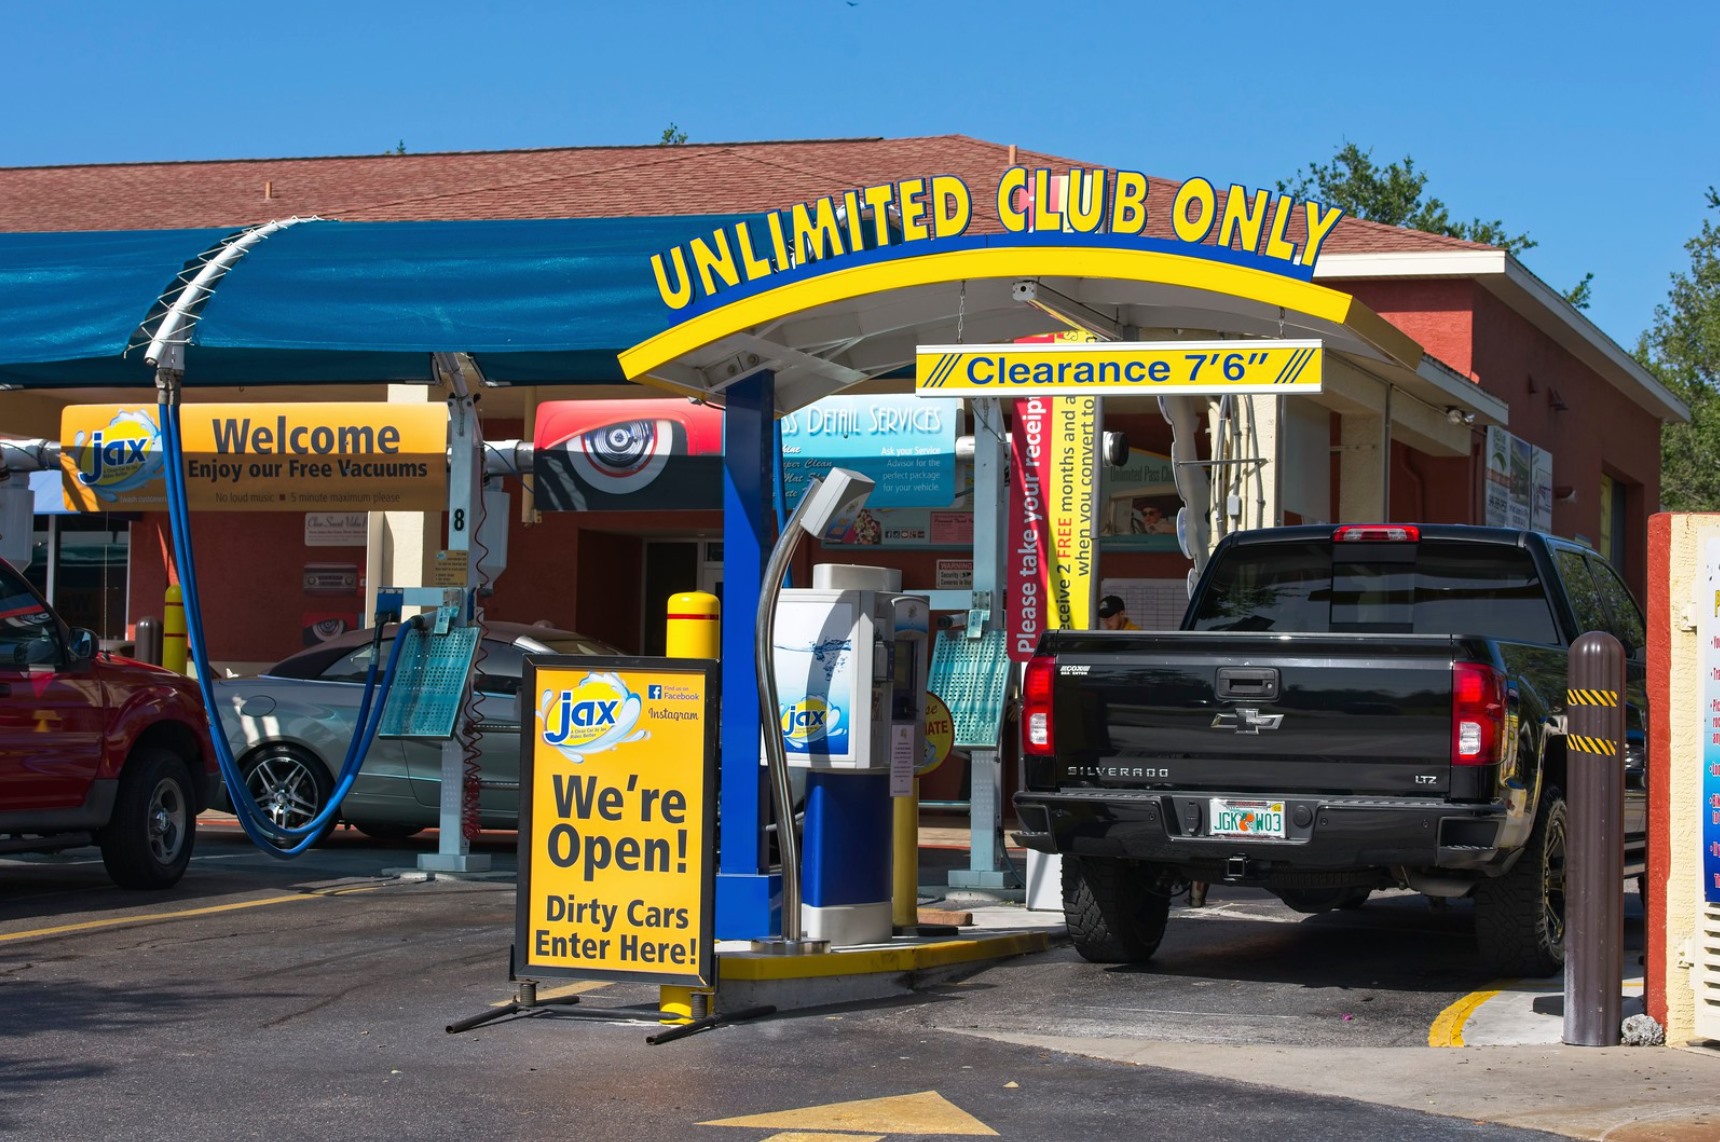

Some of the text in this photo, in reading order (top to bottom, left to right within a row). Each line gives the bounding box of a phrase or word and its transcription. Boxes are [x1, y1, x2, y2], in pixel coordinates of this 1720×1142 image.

[650, 165, 1346, 310] UNLIMITED CLUB ONLY
[967, 353, 1170, 386] Clearance
[212, 415, 401, 455] Welcome
[1061, 410, 1076, 442] and
[804, 458, 833, 468] Clean
[881, 446, 941, 457] Ask your Service
[887, 458, 941, 468] Advisor for the
[188, 459, 428, 482] Enjoy our Free Vacuums
[883, 471, 941, 482] perfect package
[1058, 447, 1075, 512] months
[1144, 465, 1161, 482] Pass
[215, 491, 401, 504] No loud music 5 minute maximum please
[883, 482, 893, 491] for
[893, 485, 911, 494] your
[1024, 473, 1043, 523] your
[1074, 398, 1095, 577] when you convert to
[453, 508, 465, 531] 8
[1056, 517, 1072, 558] FREE
[940, 562, 972, 570] WARNING
[1017, 529, 1038, 577] take
[1056, 563, 1071, 574] 2
[1016, 582, 1037, 653] Please
[1055, 579, 1071, 630] eceive
[664, 692, 700, 701] Facebook
[544, 690, 619, 744] jax
[648, 707, 699, 722] Instagram
[1067, 766, 1169, 778] SILVERADO
[1415, 775, 1437, 784] LTZ
[552, 774, 687, 824] We're
[1214, 811, 1282, 832] JGK W03
[547, 823, 688, 882] Open!
[546, 894, 689, 932] Dirty Cars
[535, 929, 697, 965] Enter Here!
